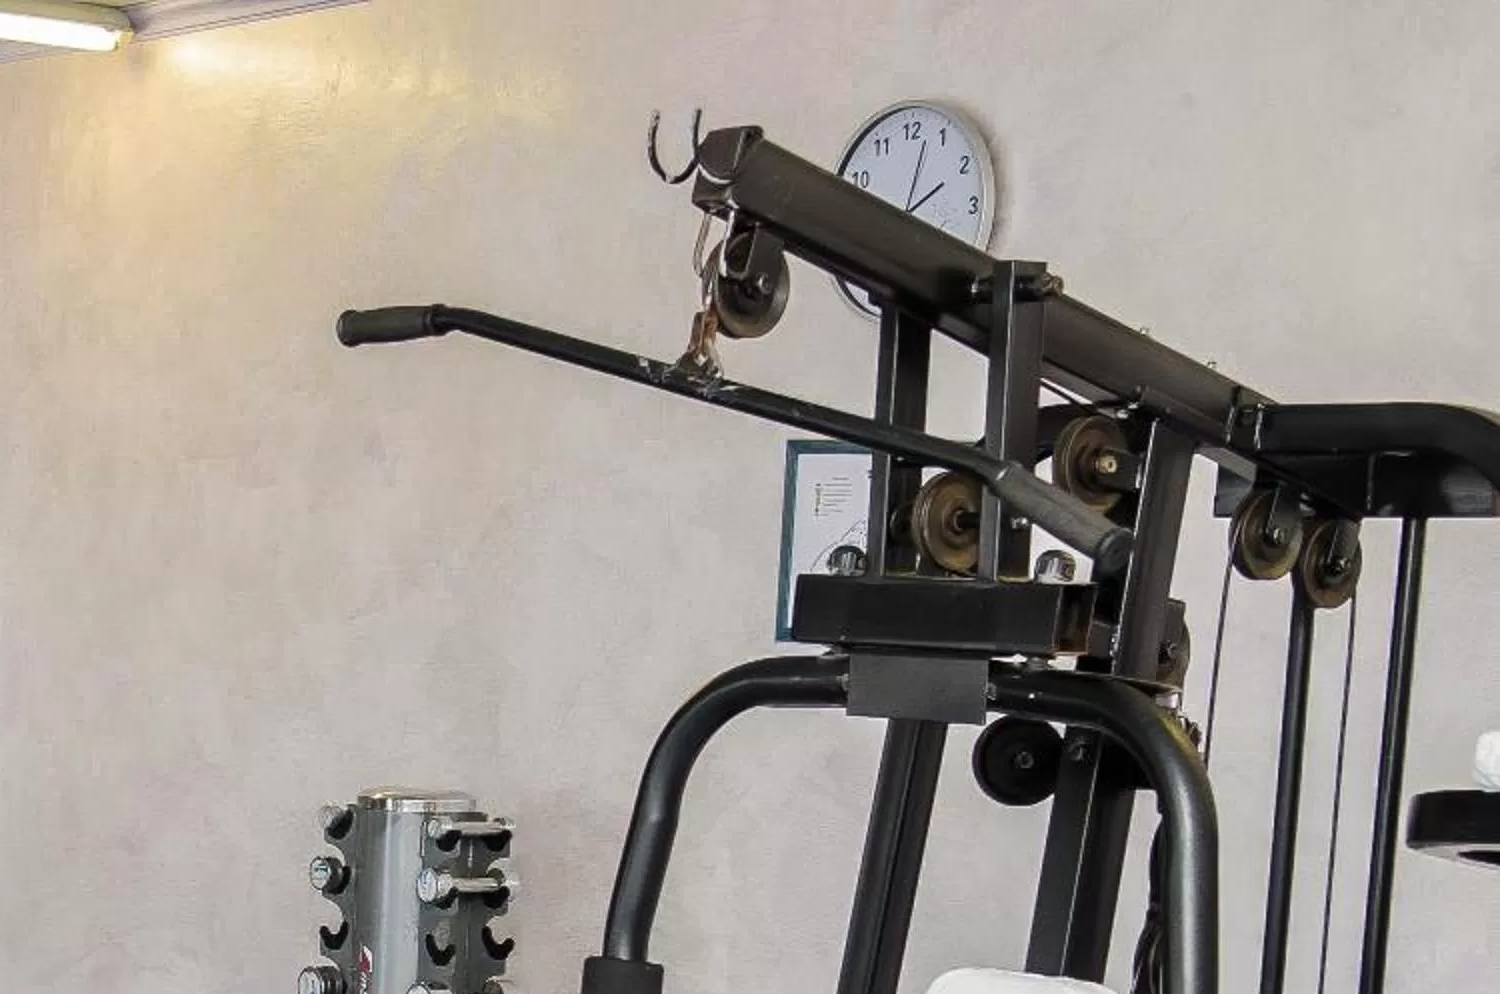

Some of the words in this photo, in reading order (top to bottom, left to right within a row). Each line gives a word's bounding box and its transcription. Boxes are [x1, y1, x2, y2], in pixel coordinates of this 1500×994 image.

[903, 121, 922, 141] 12
[939, 127, 947, 147] 1
[874, 137, 890, 156] 11
[959, 155, 970, 175] 2
[852, 171, 870, 189] 10
[968, 196, 979, 215] 3
